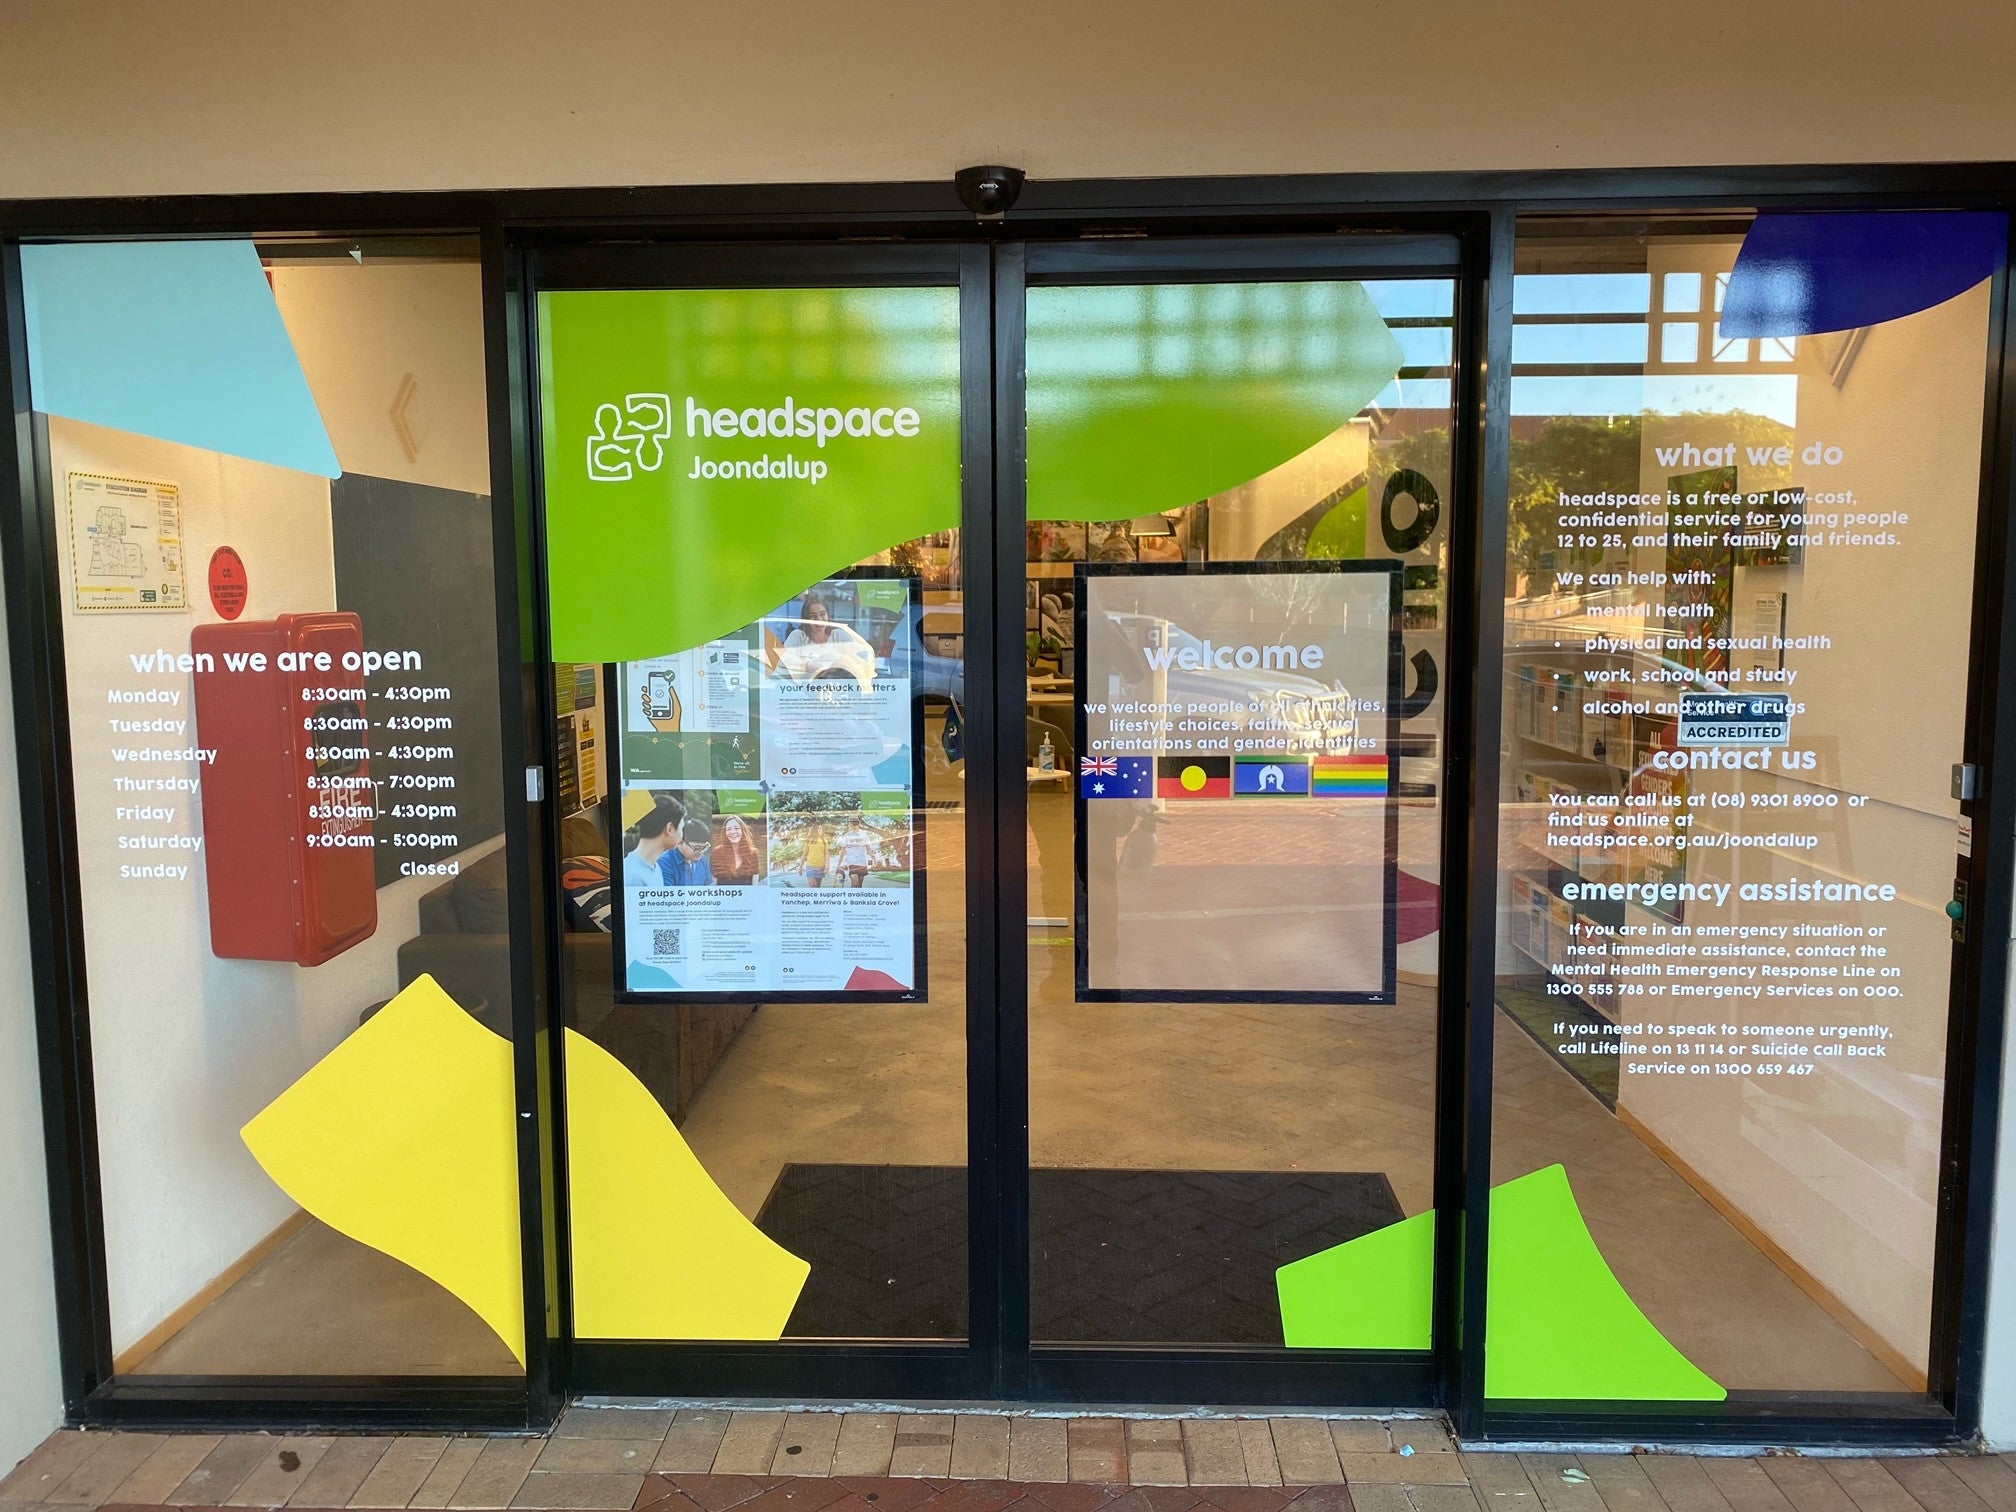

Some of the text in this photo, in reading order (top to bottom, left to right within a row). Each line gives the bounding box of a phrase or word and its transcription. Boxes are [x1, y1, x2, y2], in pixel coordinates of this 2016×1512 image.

[686, 396, 920, 447] headspace
[1656, 442, 1844, 467] what we do
[688, 454, 827, 485] Joondalup
[1559, 490, 1857, 509] headspace is a free or low-cost,
[1558, 511, 1908, 529] confidential service for young people
[1557, 571, 1716, 587] We can help with:
[1587, 604, 1714, 618] mental health
[1585, 635, 1831, 654] physical and sexual health
[130, 650, 422, 675] when we are open
[1144, 640, 1324, 671] welcome
[1584, 668, 1798, 686] work, school and study
[108, 686, 450, 705] Monday 8:30am 4:30pm
[780, 684, 805, 693] your
[807, 683, 853, 692] feedback
[1084, 703, 1106, 714] we
[1112, 700, 1181, 714] welcome
[1188, 701, 1243, 715] people
[1248, 700, 1266, 713] of
[1583, 701, 1650, 715] alcohol
[1655, 701, 1690, 715] and
[1695, 700, 1746, 715] other
[1751, 701, 1805, 718] drugs
[110, 716, 452, 734] Tuesday 8:30am 4:30pm
[1109, 718, 1174, 733] lifestyle
[1178, 718, 1243, 732] choices,
[1304, 717, 1358, 730] sexual
[1687, 727, 1781, 738] ACCREDITED
[1092, 735, 1376, 752] orientations and gender identities
[112, 745, 453, 764] Wednesday 8:30am 4:30pm
[1653, 747, 1772, 770] contact
[1782, 751, 1816, 770] us
[113, 775, 455, 793] Thursday 8:30am 7:00pm
[1549, 792, 1868, 809] You can call us at (08) 9301 8900 or
[116, 804, 456, 822] Friday 8:30am 4:30pm
[1548, 814, 1583, 827] find
[1588, 814, 1608, 827] us
[1614, 813, 1669, 827] online
[1675, 814, 1693, 827] at
[118, 833, 457, 852] Saturday 9:00am 5:00pm
[1547, 833, 1818, 850] headspace.org.au/joondalup
[121, 861, 459, 880] Sunday Closed
[639, 890, 674, 899] groups
[688, 889, 742, 897] workshops
[1562, 878, 1896, 906] emergency assistance
[1569, 924, 1886, 940] If you are in an emergency situation or
[1552, 963, 1900, 979] Mental Health Emergency Response Line on
[1546, 983, 1583, 995] 1300
[1588, 984, 1613, 995] 555
[1618, 983, 1644, 995] 788
[1649, 984, 1666, 995] or
[1671, 984, 1762, 999] Emergency
[1766, 984, 1833, 997] Services
[1838, 985, 1858, 997] on
[1553, 1023, 1893, 1039] If you need to speak to someone urgently,
[1628, 1062, 1814, 1075] Service on 1300 659 467
